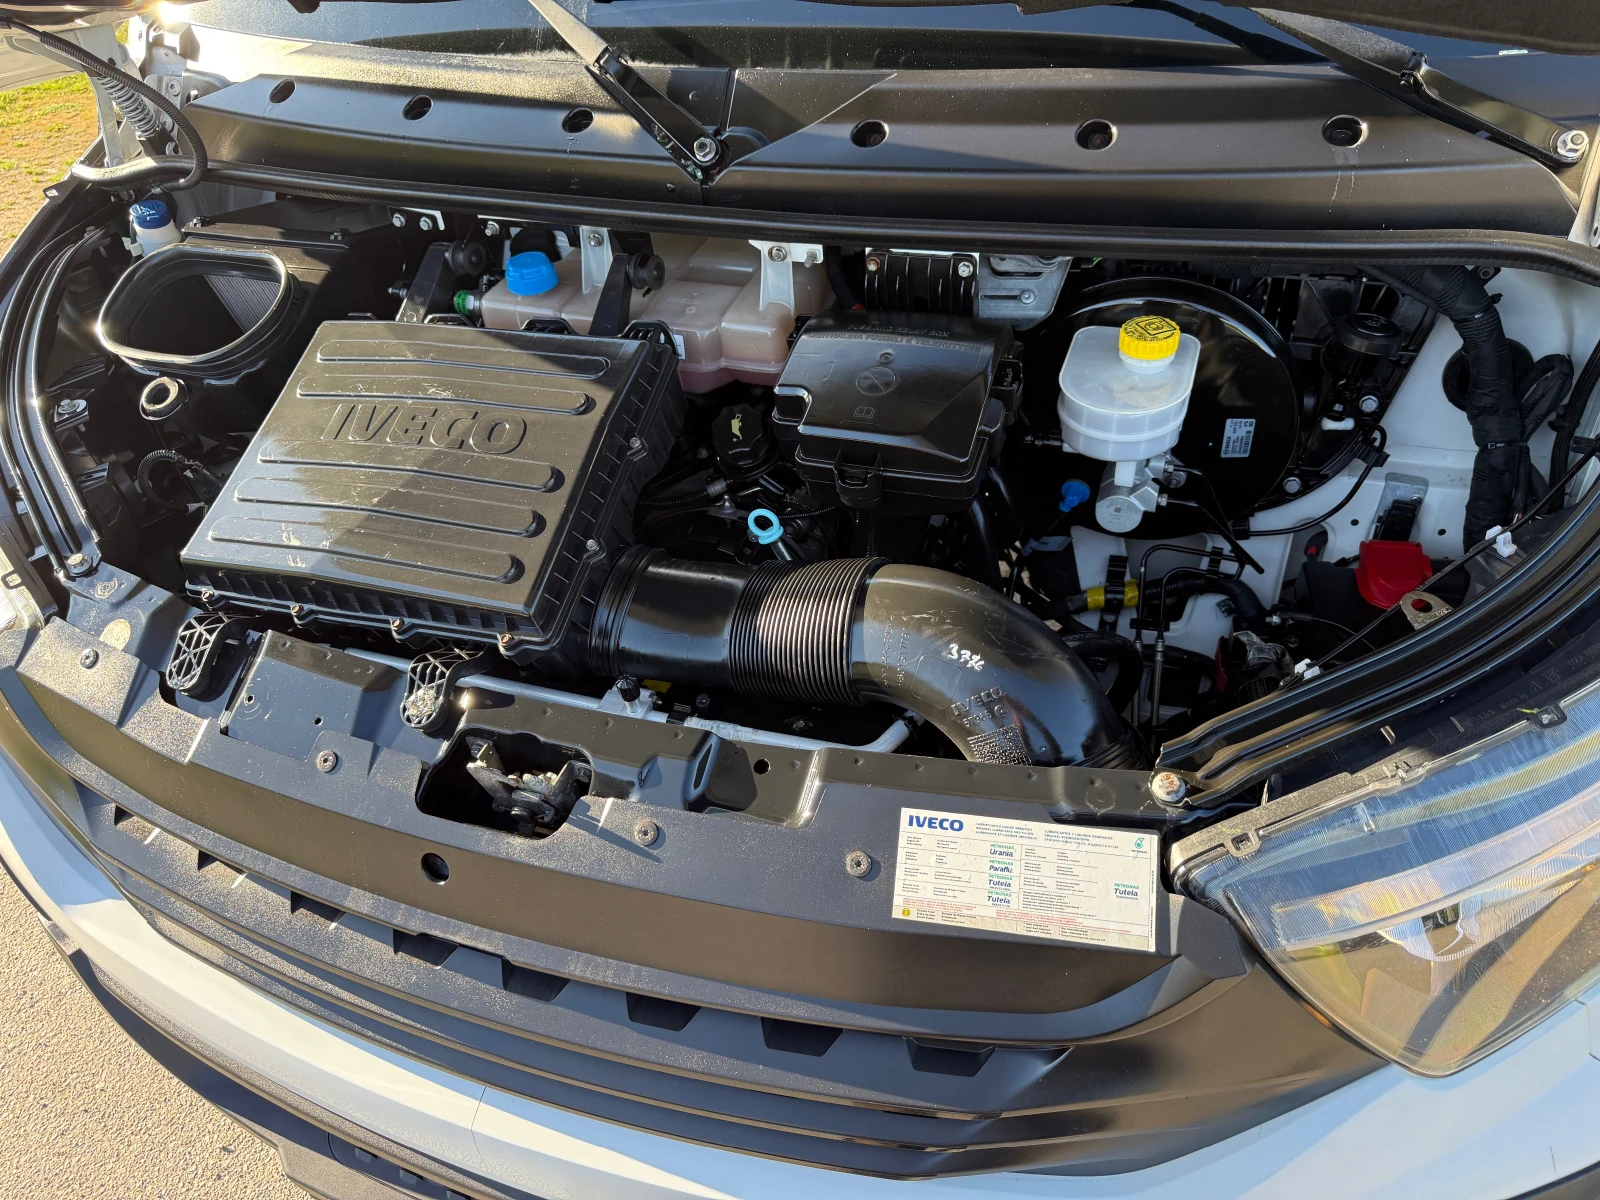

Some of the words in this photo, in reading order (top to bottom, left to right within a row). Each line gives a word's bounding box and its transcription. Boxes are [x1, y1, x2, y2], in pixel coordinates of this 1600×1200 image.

[320, 403, 528, 455] IVECO
[950, 685, 1004, 716] IVECO
[908, 814, 964, 832] IVECO
[989, 848, 1014, 858] Urania
[988, 864, 1013, 874] Paraflu
[988, 879, 1011, 888] Tutela
[1113, 887, 1138, 897] Tutela
[987, 895, 1011, 905] Tutela
